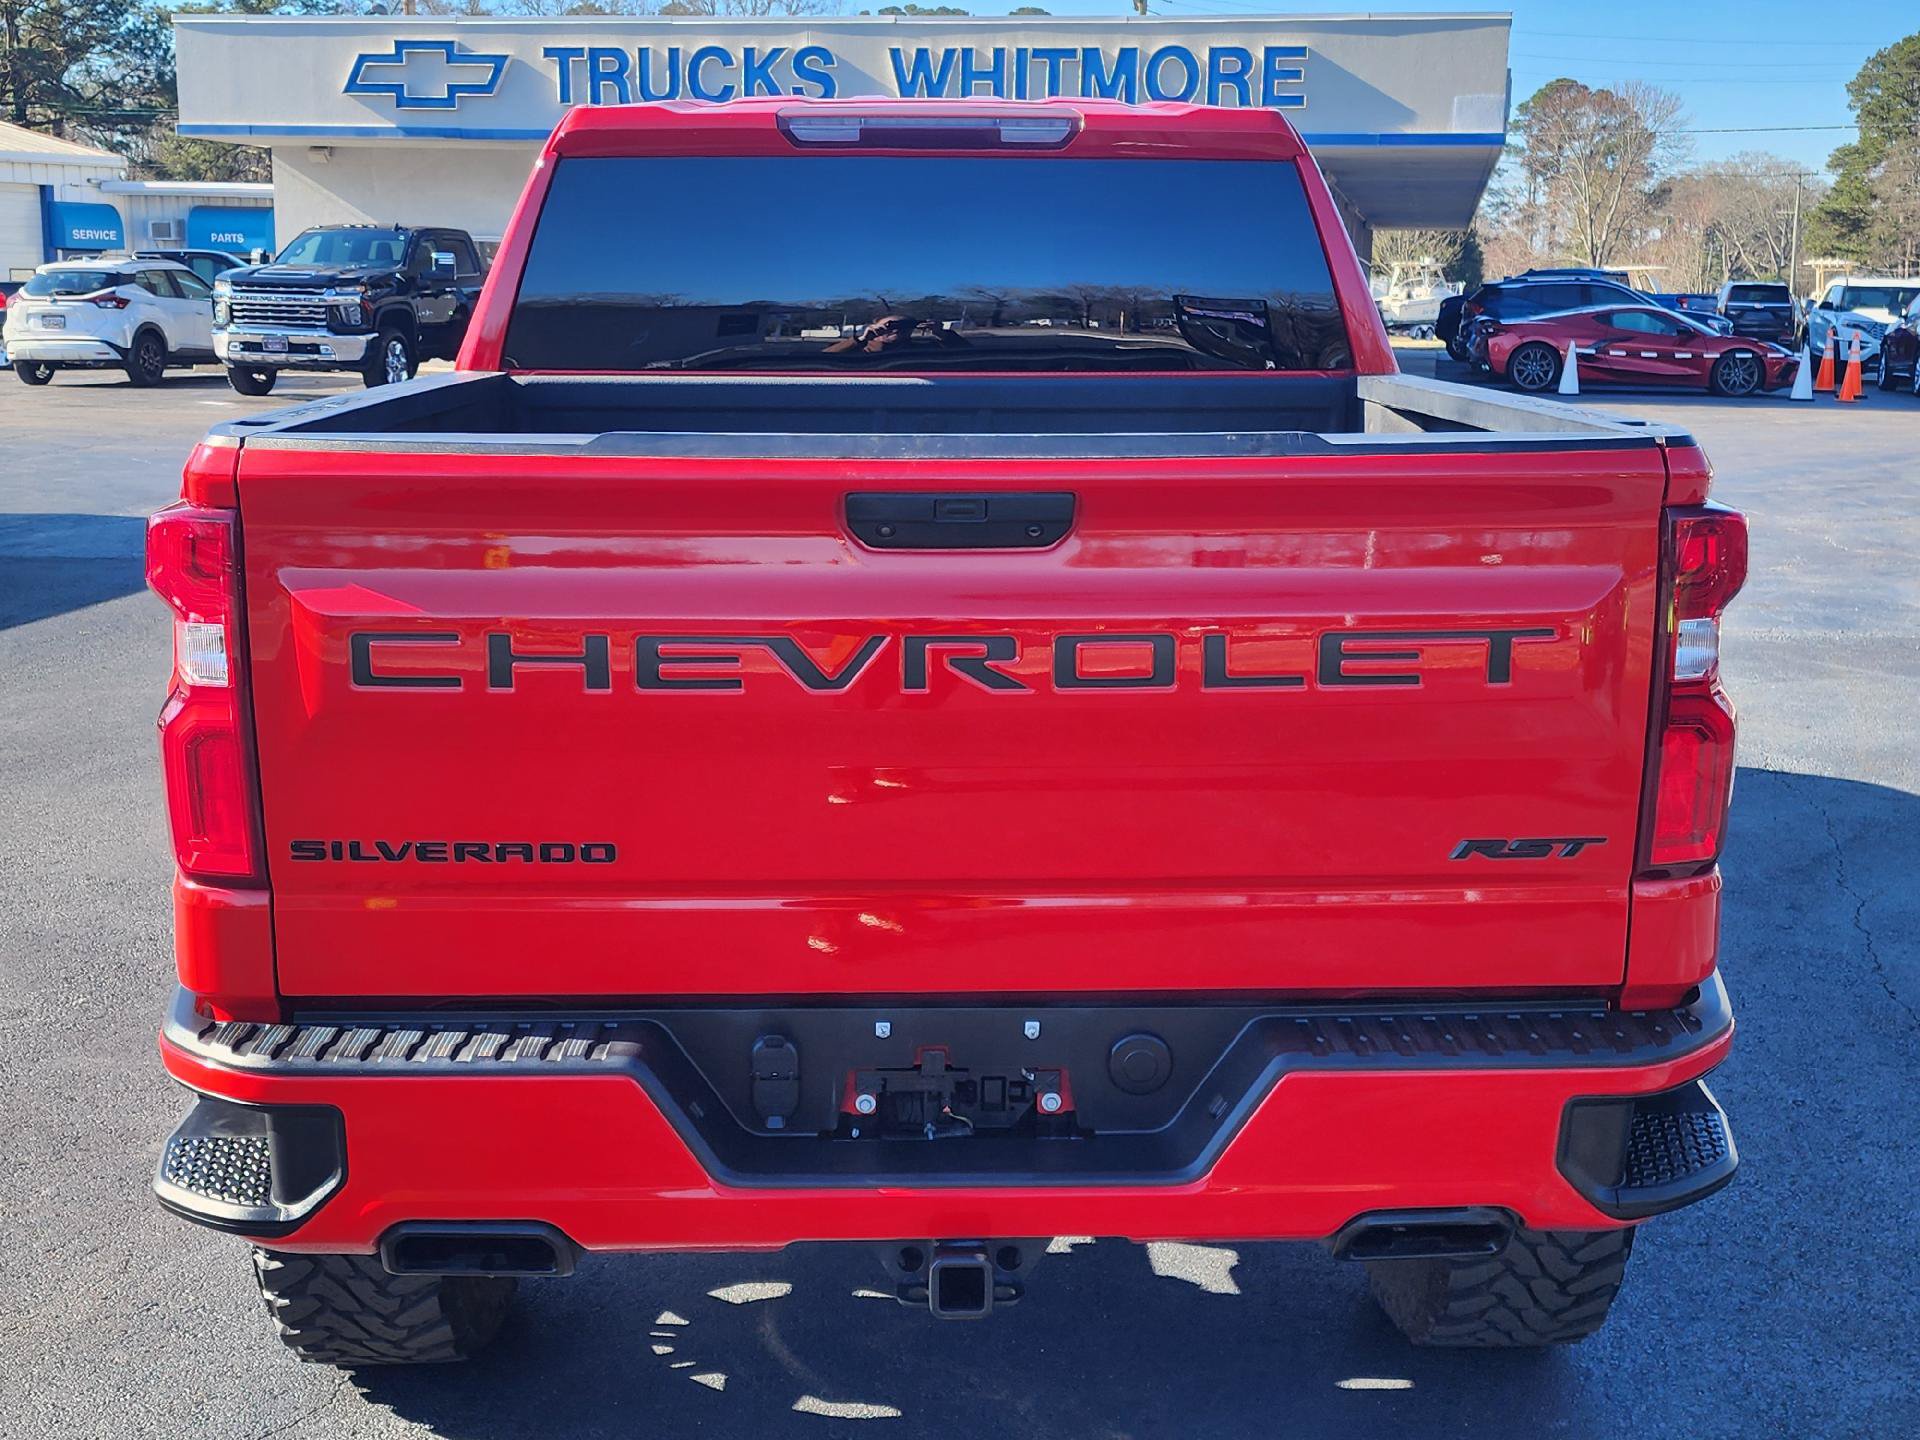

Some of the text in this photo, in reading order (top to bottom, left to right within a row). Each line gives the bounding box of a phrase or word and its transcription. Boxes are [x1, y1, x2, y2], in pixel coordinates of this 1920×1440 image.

[543, 45, 1308, 108] TRUCKS WHITMORE
[72, 229, 118, 241] SERVICE
[211, 233, 245, 244] PARTS
[350, 629, 1559, 695] CHEVROLET
[290, 840, 617, 864] SILVERADO
[1448, 837, 1607, 861] RST
